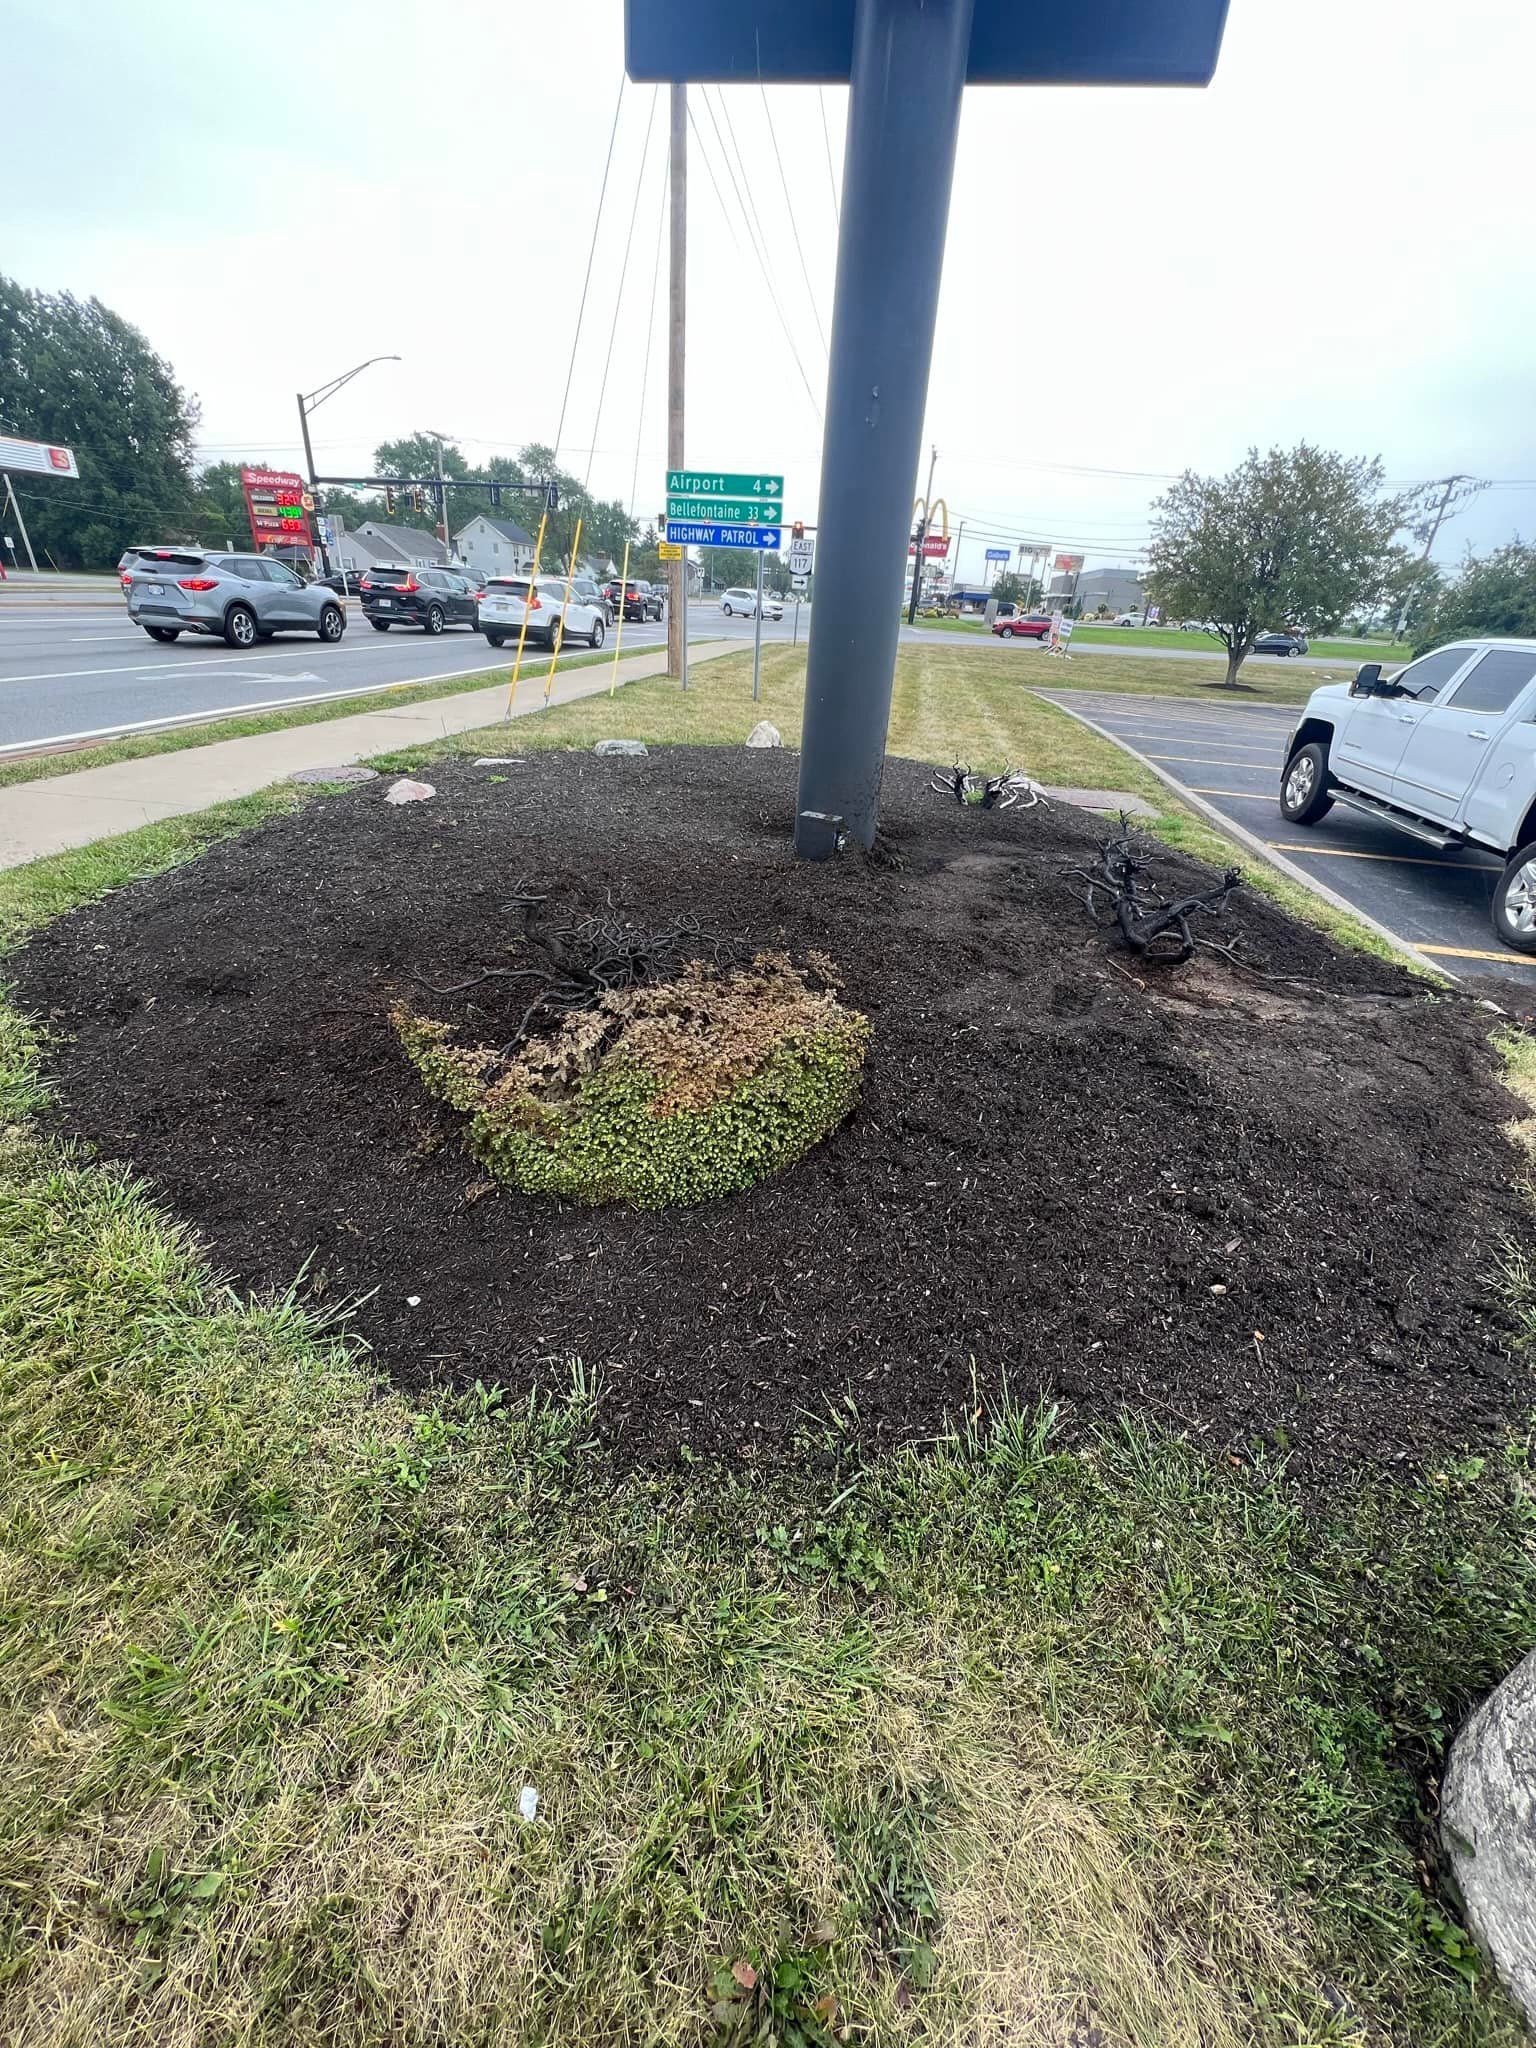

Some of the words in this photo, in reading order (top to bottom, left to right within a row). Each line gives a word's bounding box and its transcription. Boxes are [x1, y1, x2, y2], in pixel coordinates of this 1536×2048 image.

[248, 473, 300, 487] Speedway
[670, 475, 725, 493] Airport
[753, 480, 762, 493] 4
[670, 502, 740, 519] Bellefontaine
[748, 507, 759, 520] 33
[670, 528, 715, 542] HIGHWAY
[721, 530, 759, 545] PATROL
[793, 541, 812, 551] EAST
[794, 558, 808, 569] 117
